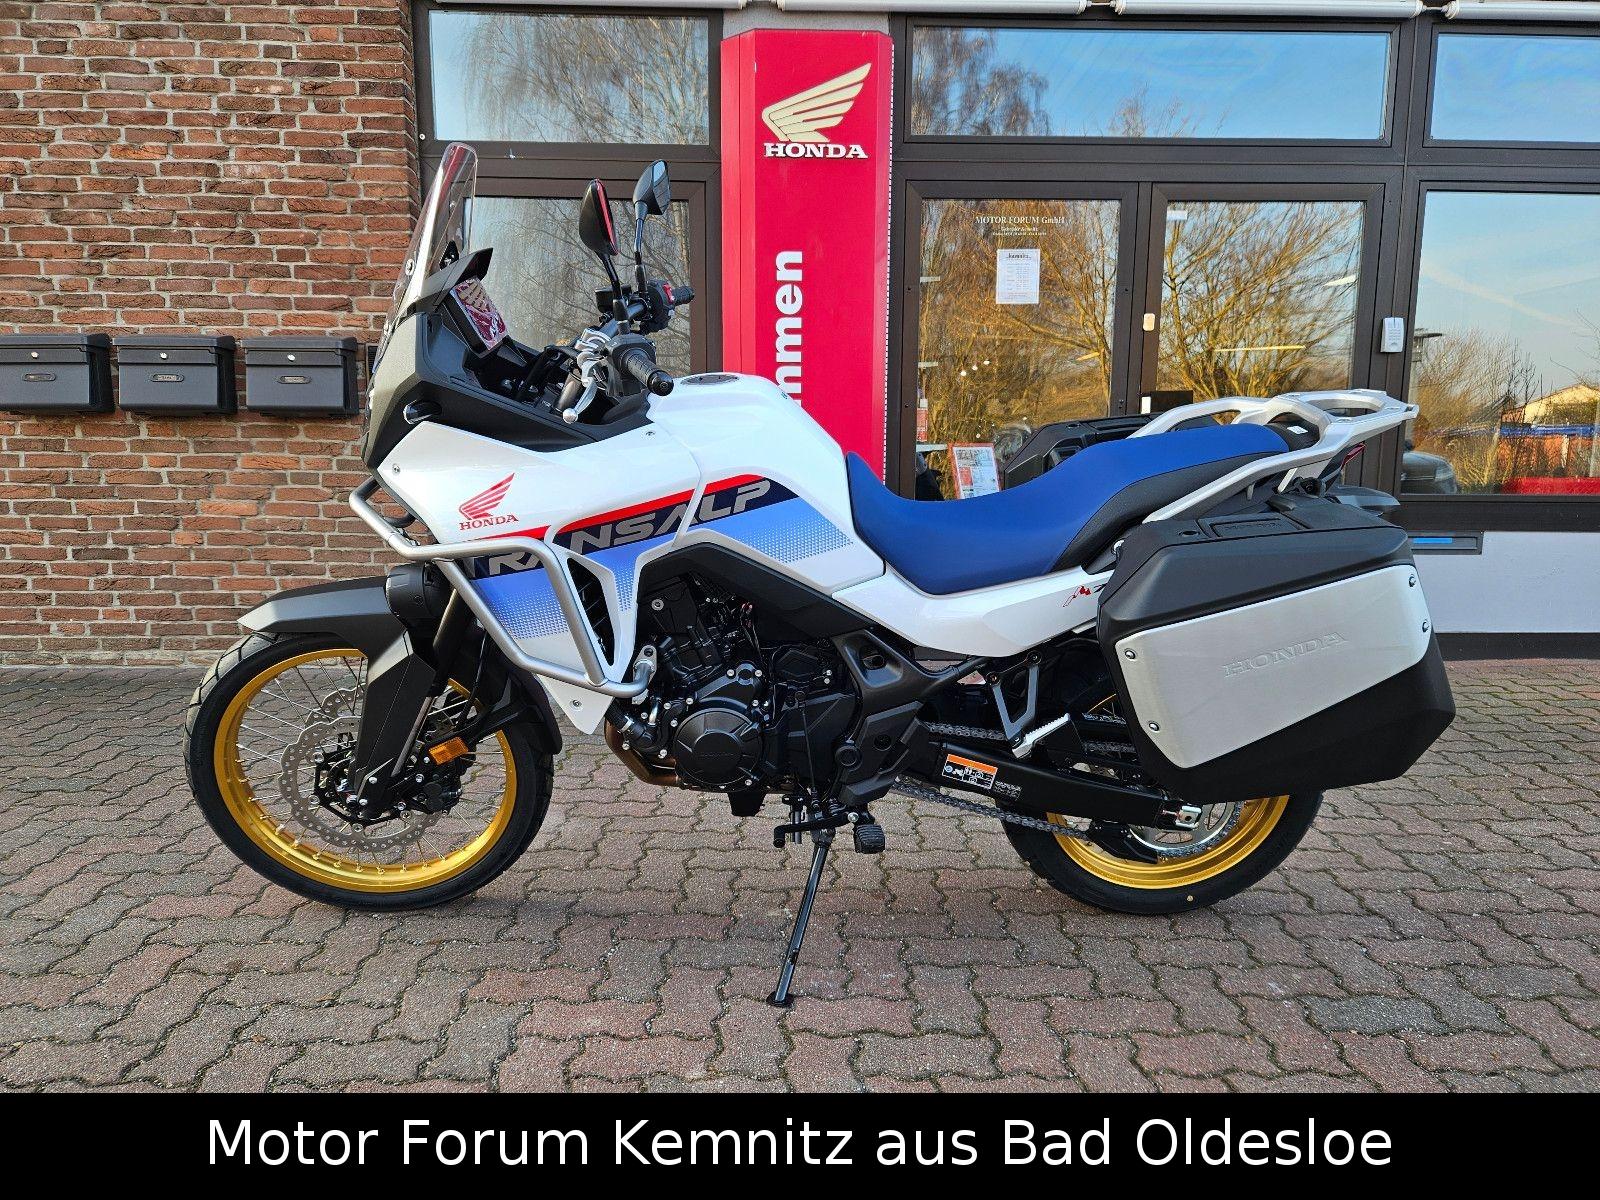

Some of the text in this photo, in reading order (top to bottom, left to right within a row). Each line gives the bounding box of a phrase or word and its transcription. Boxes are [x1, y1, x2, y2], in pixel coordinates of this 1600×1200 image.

[763, 142, 868, 160] HONDA
[975, 216, 1065, 224] MOTOR FORUM GmbH
[459, 514, 519, 531] HONDA
[1221, 631, 1349, 678] HONDA
